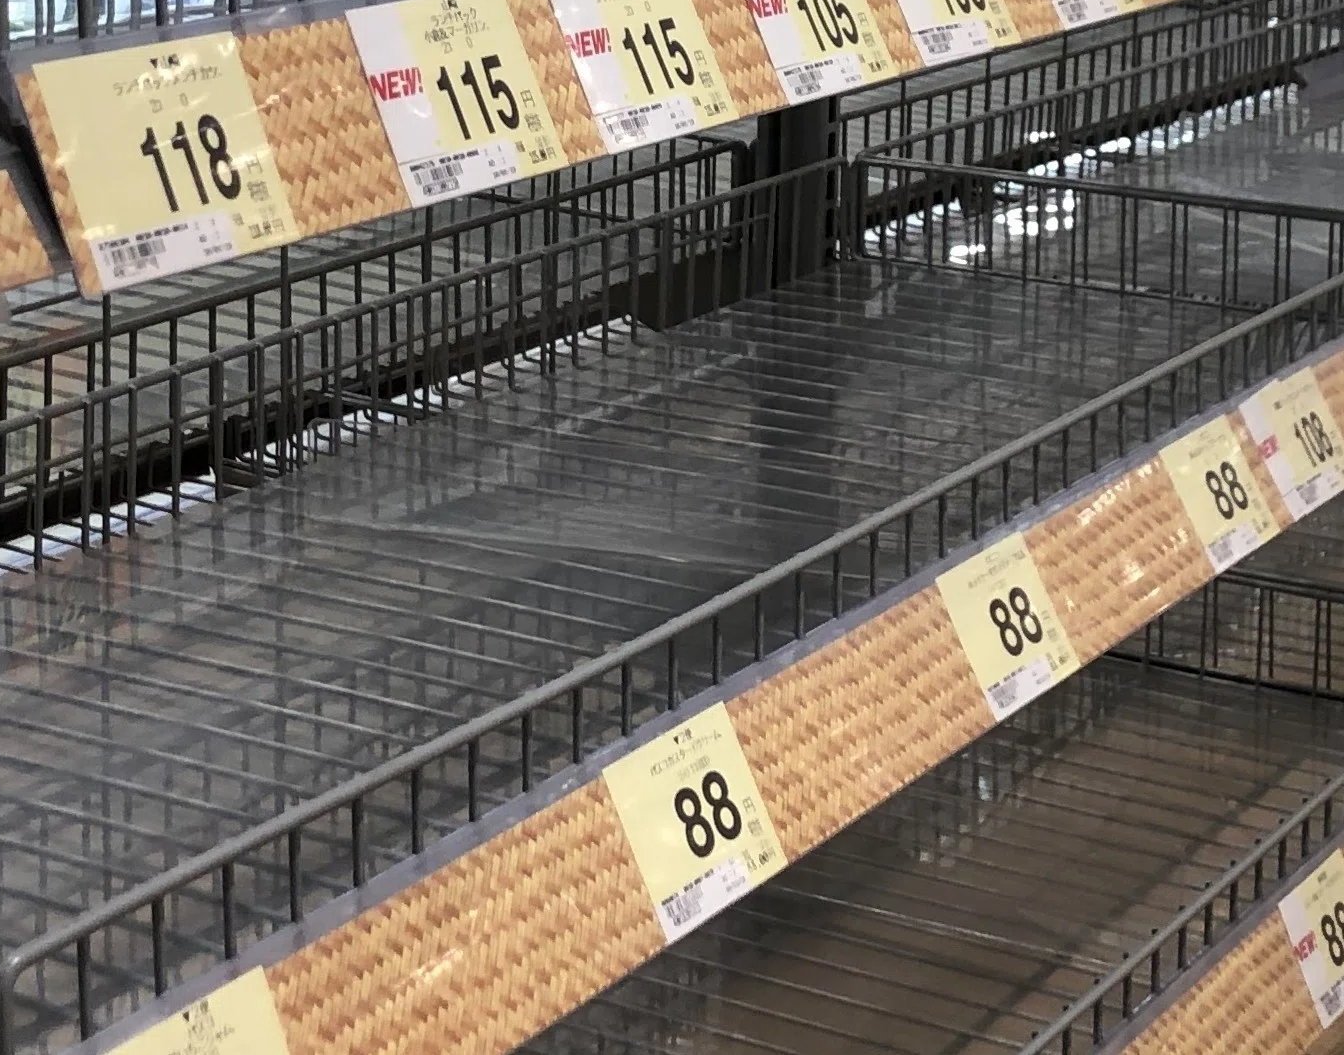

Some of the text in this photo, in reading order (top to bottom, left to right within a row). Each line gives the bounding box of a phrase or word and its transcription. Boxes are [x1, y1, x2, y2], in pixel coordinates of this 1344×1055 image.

[564, 27, 613, 58] NEW!
[621, 17, 695, 96] 115
[368, 66, 424, 102] NEW!
[436, 54, 520, 141] 115
[140, 113, 242, 213] 118
[1205, 460, 1250, 521] 88
[989, 586, 1044, 657] 88
[674, 769, 743, 859] 88
